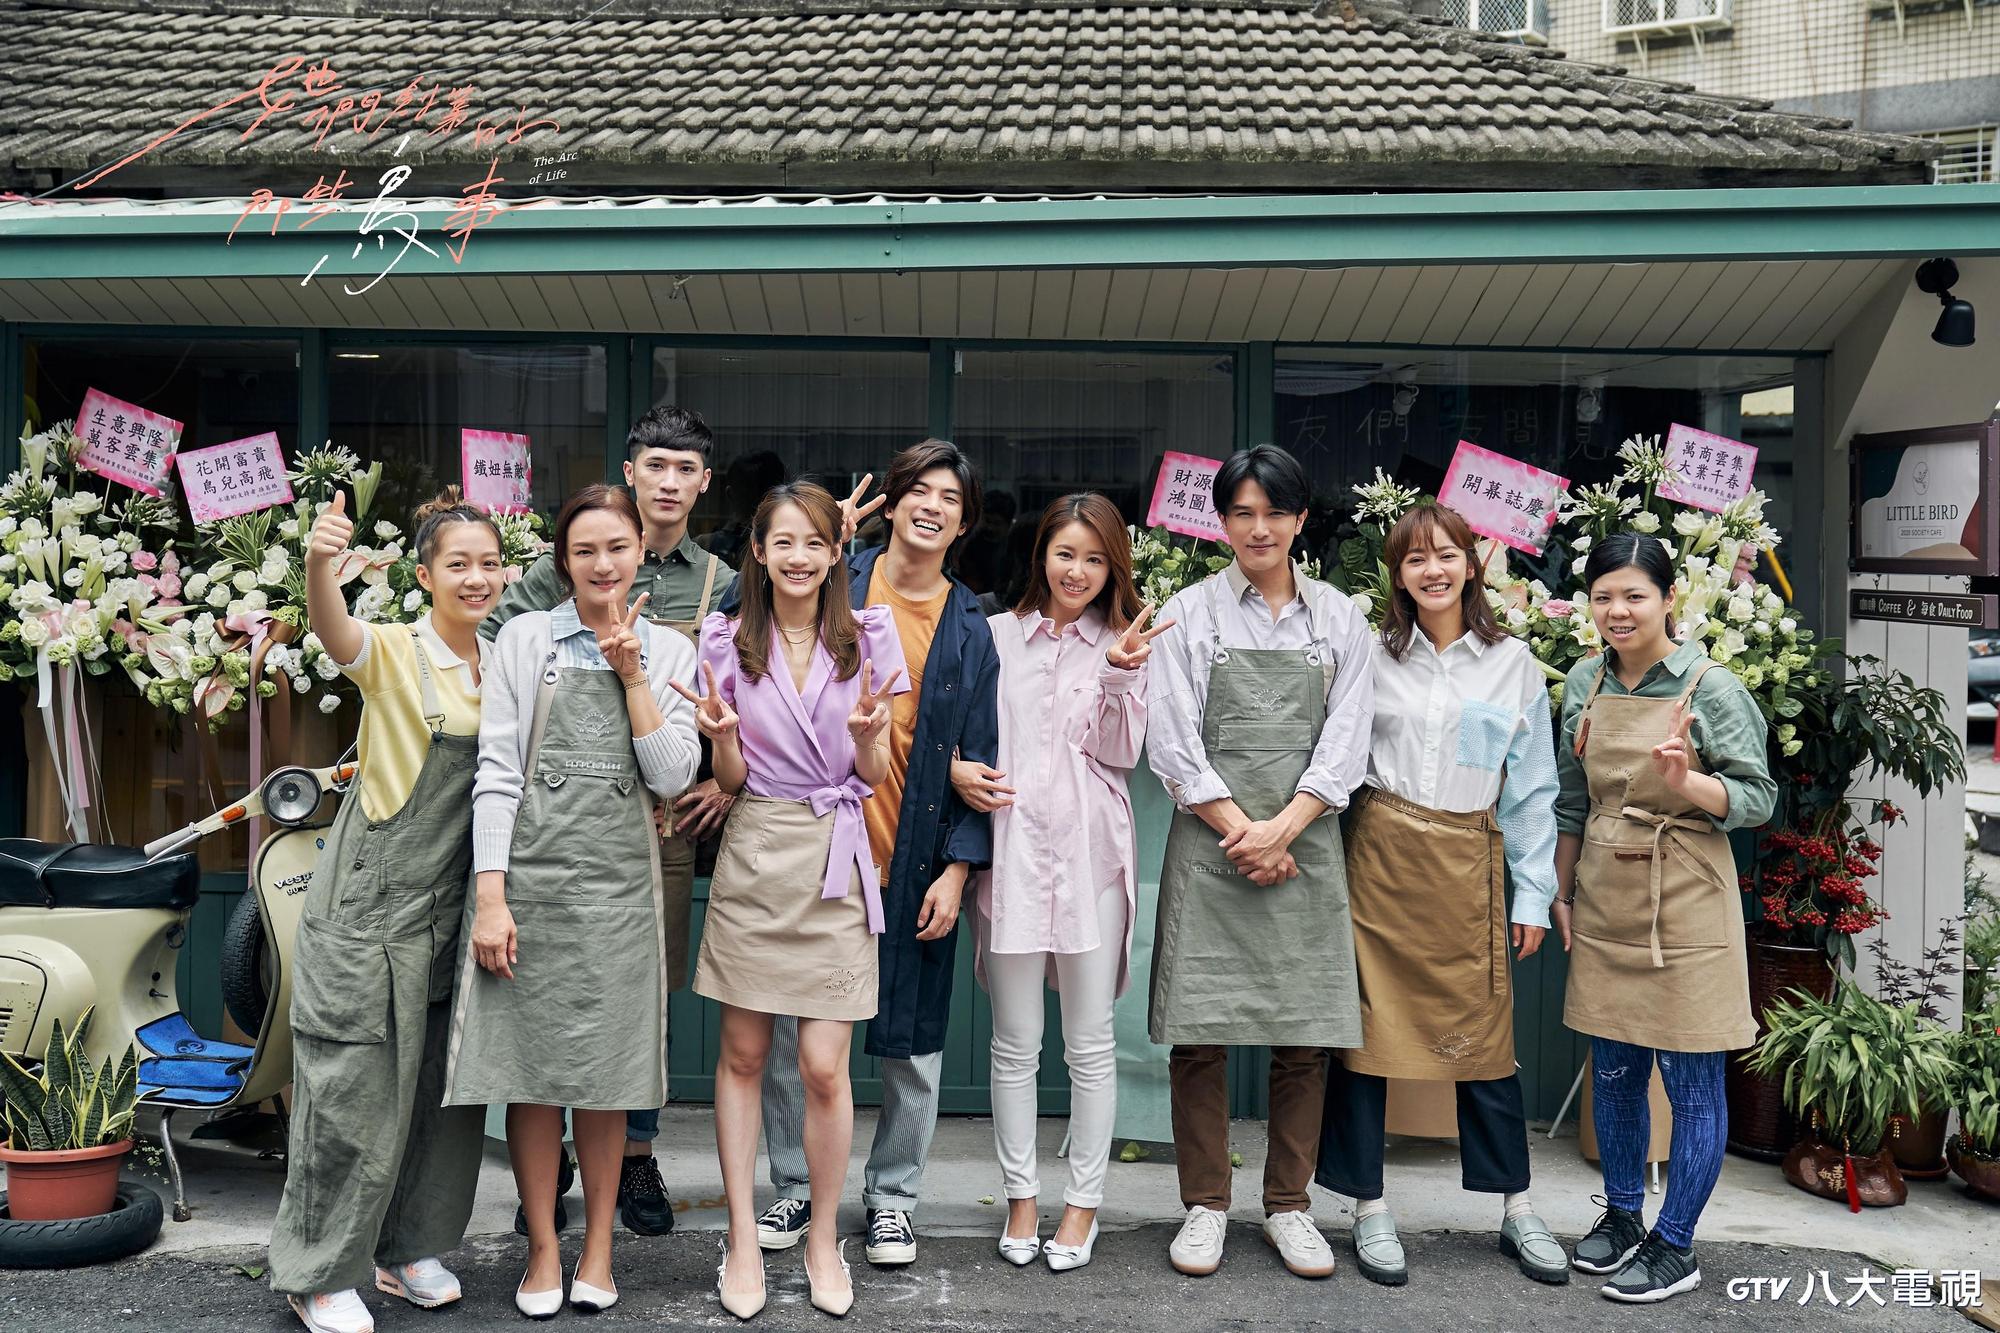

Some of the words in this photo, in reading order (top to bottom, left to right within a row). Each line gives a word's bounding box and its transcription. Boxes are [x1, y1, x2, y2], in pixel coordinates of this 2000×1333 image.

[91, 408, 165, 450] 生意興隆
[86, 428, 158, 471] 萬客雲集
[195, 446, 267, 477] 花開富貴
[1682, 440, 1744, 472] 萬商雲集
[202, 465, 275, 495] 鳥兒高飛
[473, 459, 524, 479] 鐵妞無敵
[1172, 469, 1212, 491] 財源
[1676, 459, 1740, 490] 大業千春
[1167, 489, 1218, 515] 鴻圖
[1462, 474, 1545, 518] 開幕誌慶
[1886, 505, 1926, 521] LITTLE
[1928, 504, 1959, 520] BIRD
[1906, 599, 1917, 616] &
